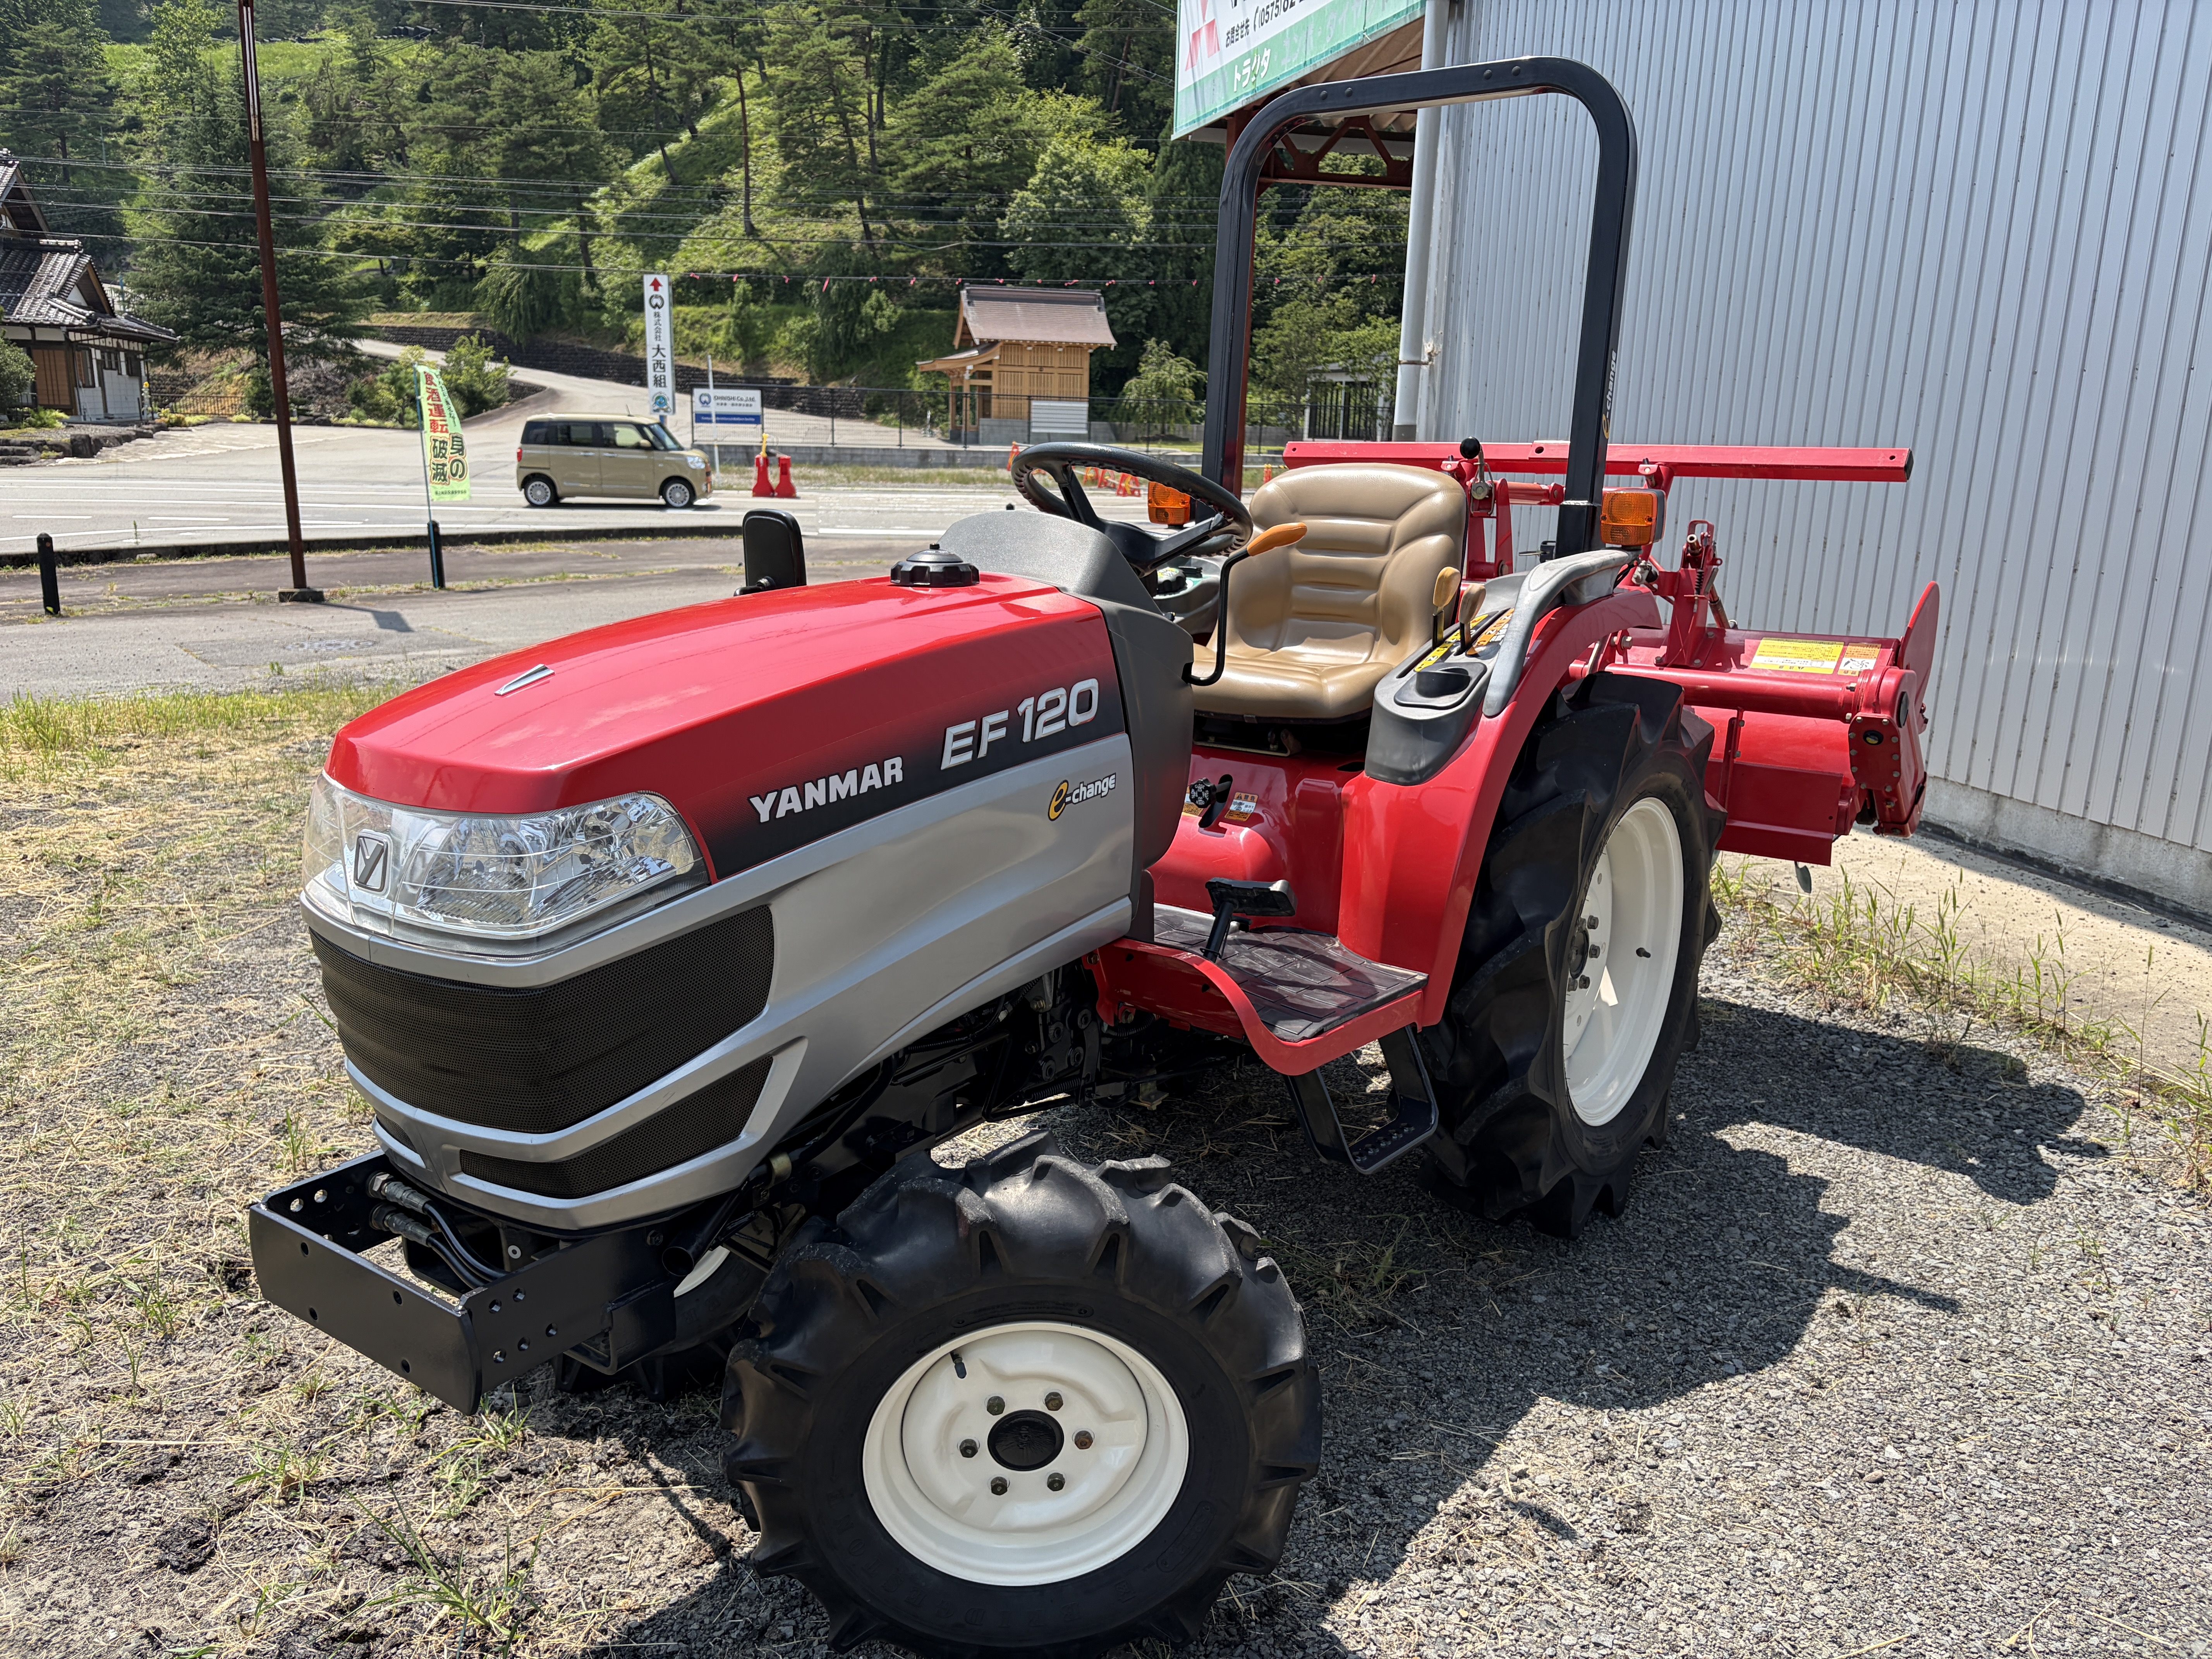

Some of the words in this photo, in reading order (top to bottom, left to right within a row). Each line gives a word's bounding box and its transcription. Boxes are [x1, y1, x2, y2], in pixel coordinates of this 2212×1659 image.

[1226, 17, 1249, 48] お問合せ先
[1234, 48, 1271, 92] トラクタ
[653, 311, 662, 341] 株式会社
[652, 344, 667, 388] 大西組
[1602, 350, 1617, 439] e-change
[940, 709, 1009, 771] EF
[1017, 678, 1099, 744] 120
[749, 756, 903, 824] YANMAR
[1048, 773, 1117, 822] e-change
[826, 1489, 1081, 1628] BRIDGESTONE
